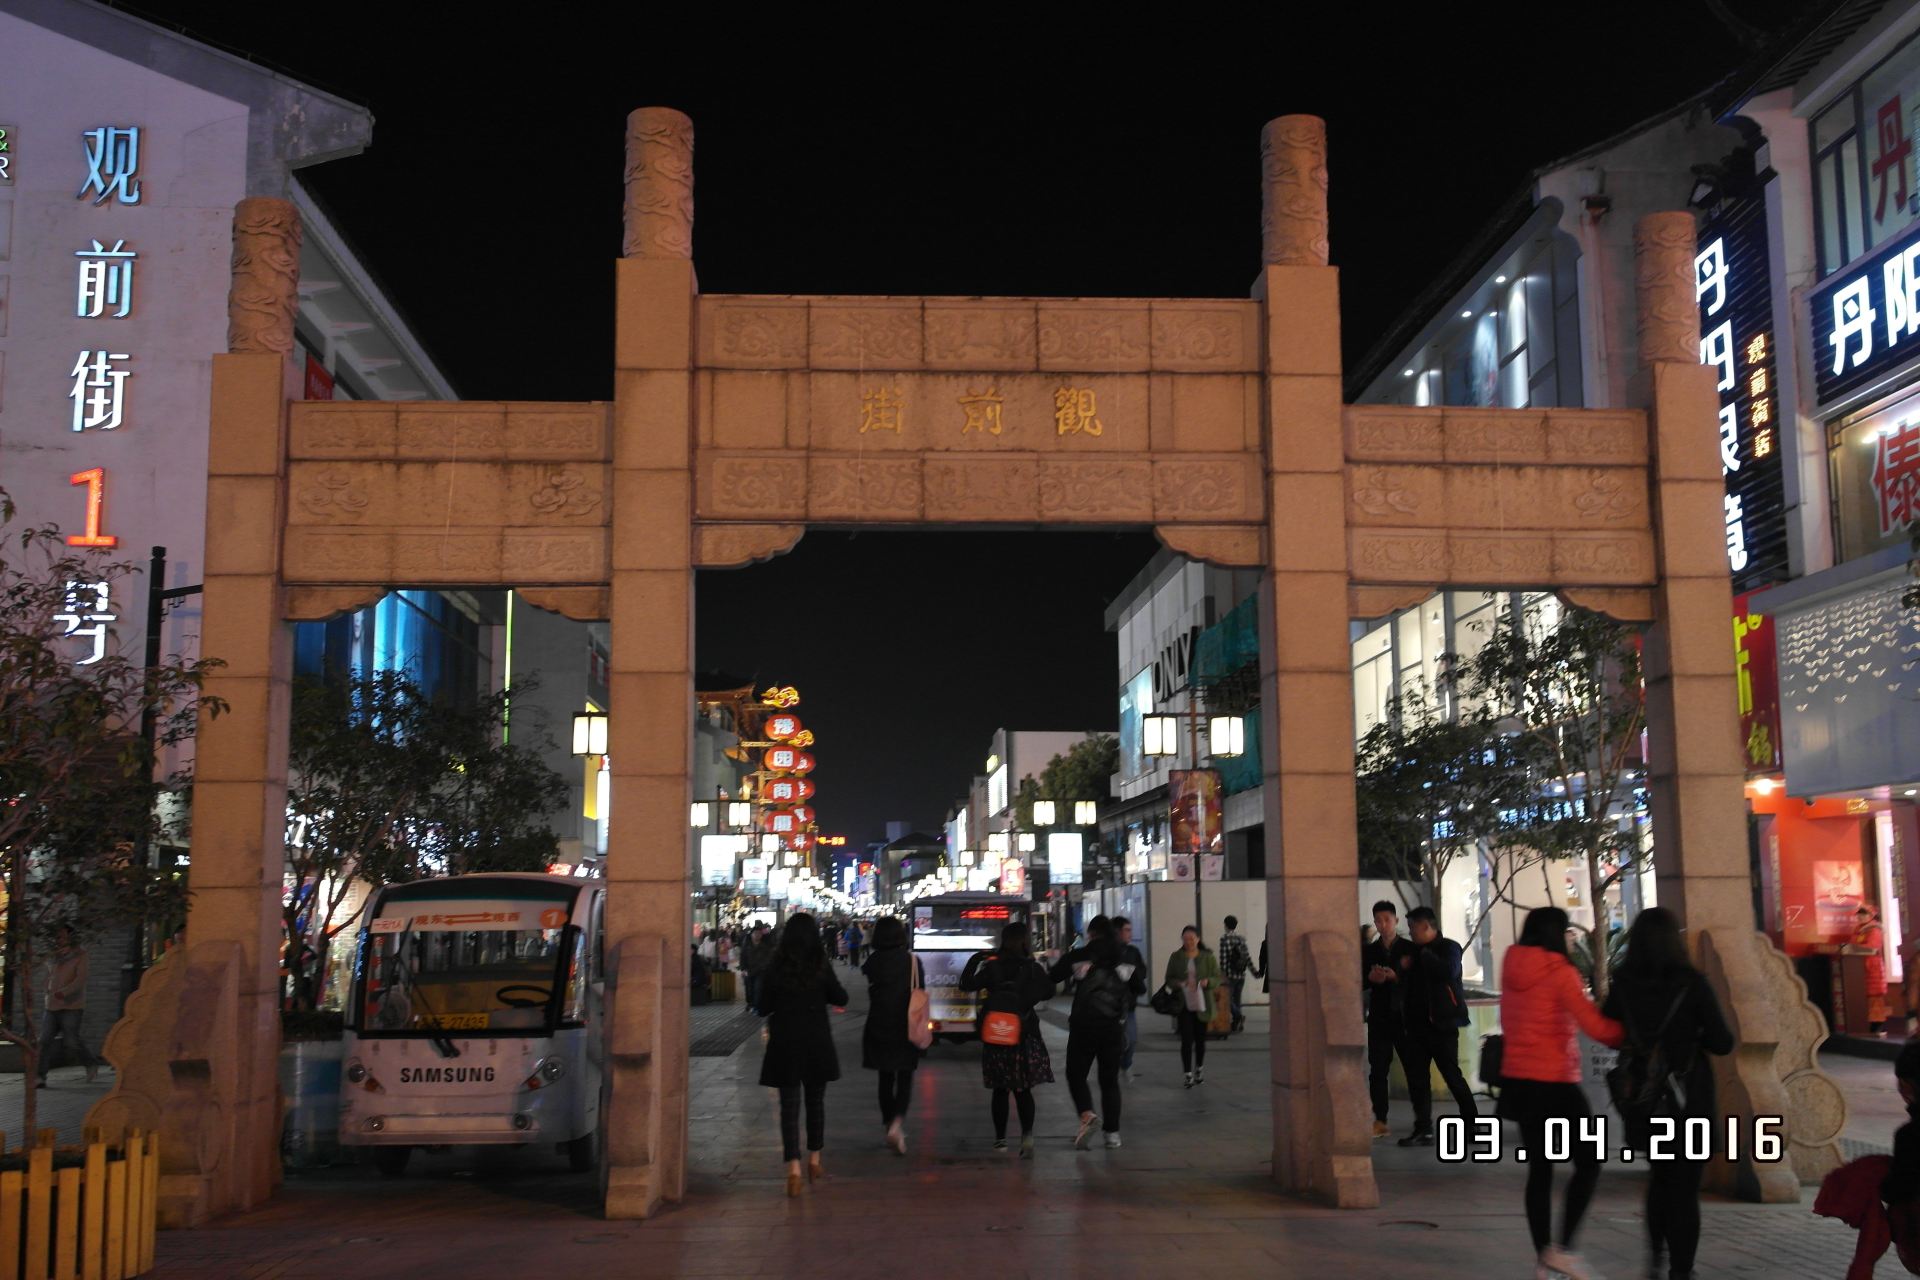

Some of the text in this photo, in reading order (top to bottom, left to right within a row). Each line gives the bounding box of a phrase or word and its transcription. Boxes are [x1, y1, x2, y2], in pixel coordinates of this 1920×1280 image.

[1872, 95, 1912, 225] 丹
[53, 126, 142, 666] 观前街1号
[1152, 626, 1200, 702] ONLY
[400, 1067, 494, 1083] SAMSUNG
